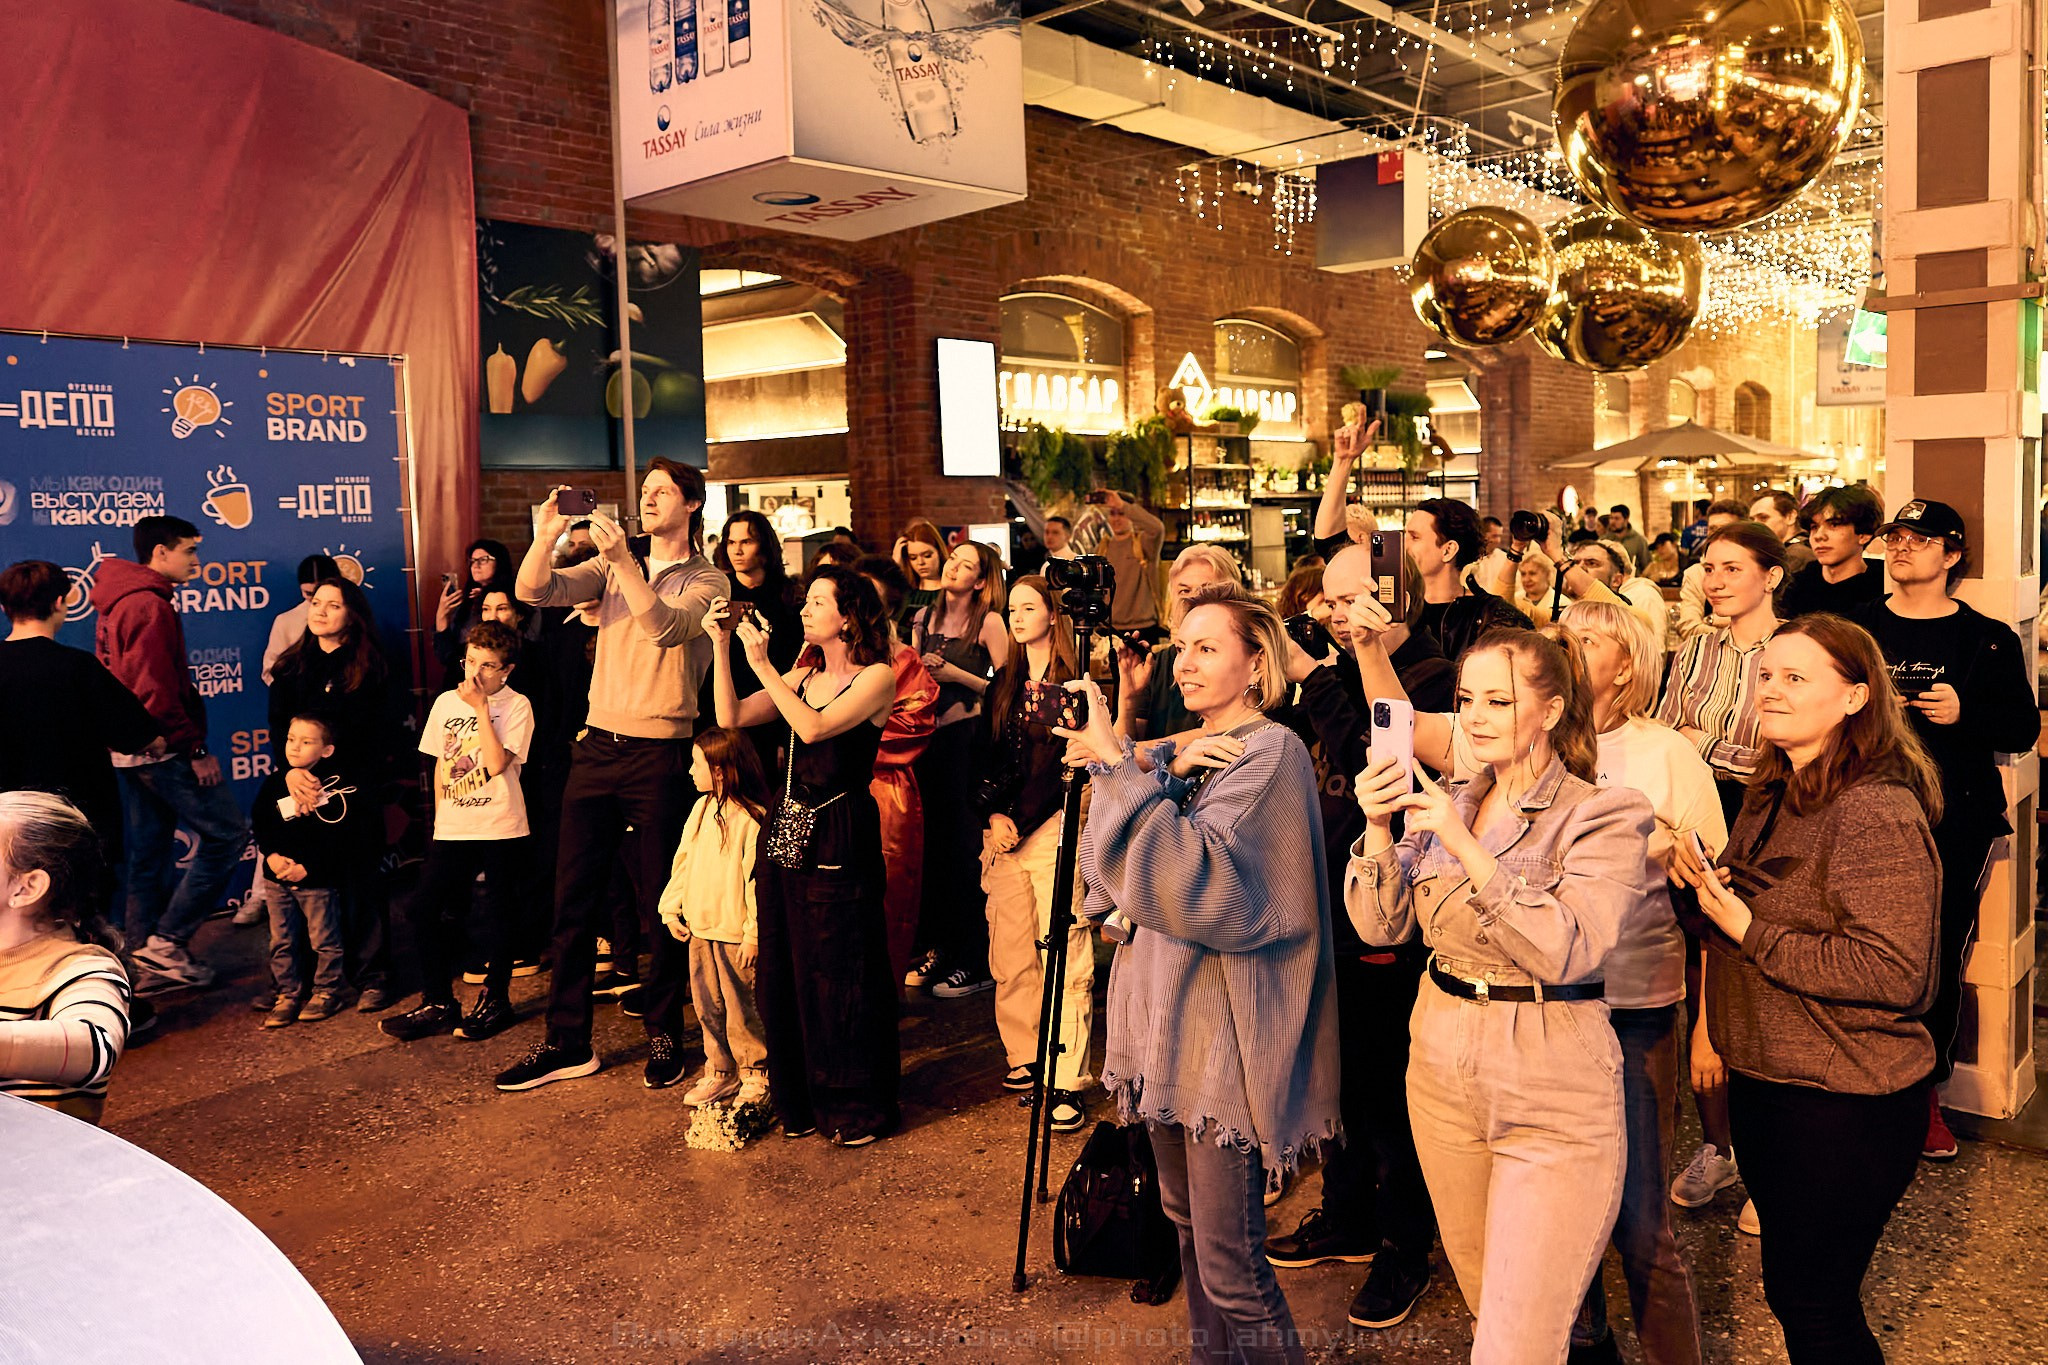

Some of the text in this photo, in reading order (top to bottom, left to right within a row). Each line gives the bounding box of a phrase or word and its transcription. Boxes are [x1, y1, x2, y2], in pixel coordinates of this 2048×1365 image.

[896, 61, 940, 81] TASSAY
[694, 109, 762, 141] Сила жизни
[642, 128, 687, 159] TASSAY
[765, 186, 917, 224] TASSAY
[999, 370, 1119, 414] ГЛАВБАР
[1213, 386, 1297, 422] ЛАВБАР
[266, 392, 365, 418] SPORT
[76, 428, 116, 437] МОСКВА
[267, 417, 367, 442] BRAND
[68, 476, 104, 491] как
[107, 476, 163, 492] один
[31, 491, 165, 512] выступаем
[51, 508, 98, 526] как
[192, 677, 244, 698] дин
